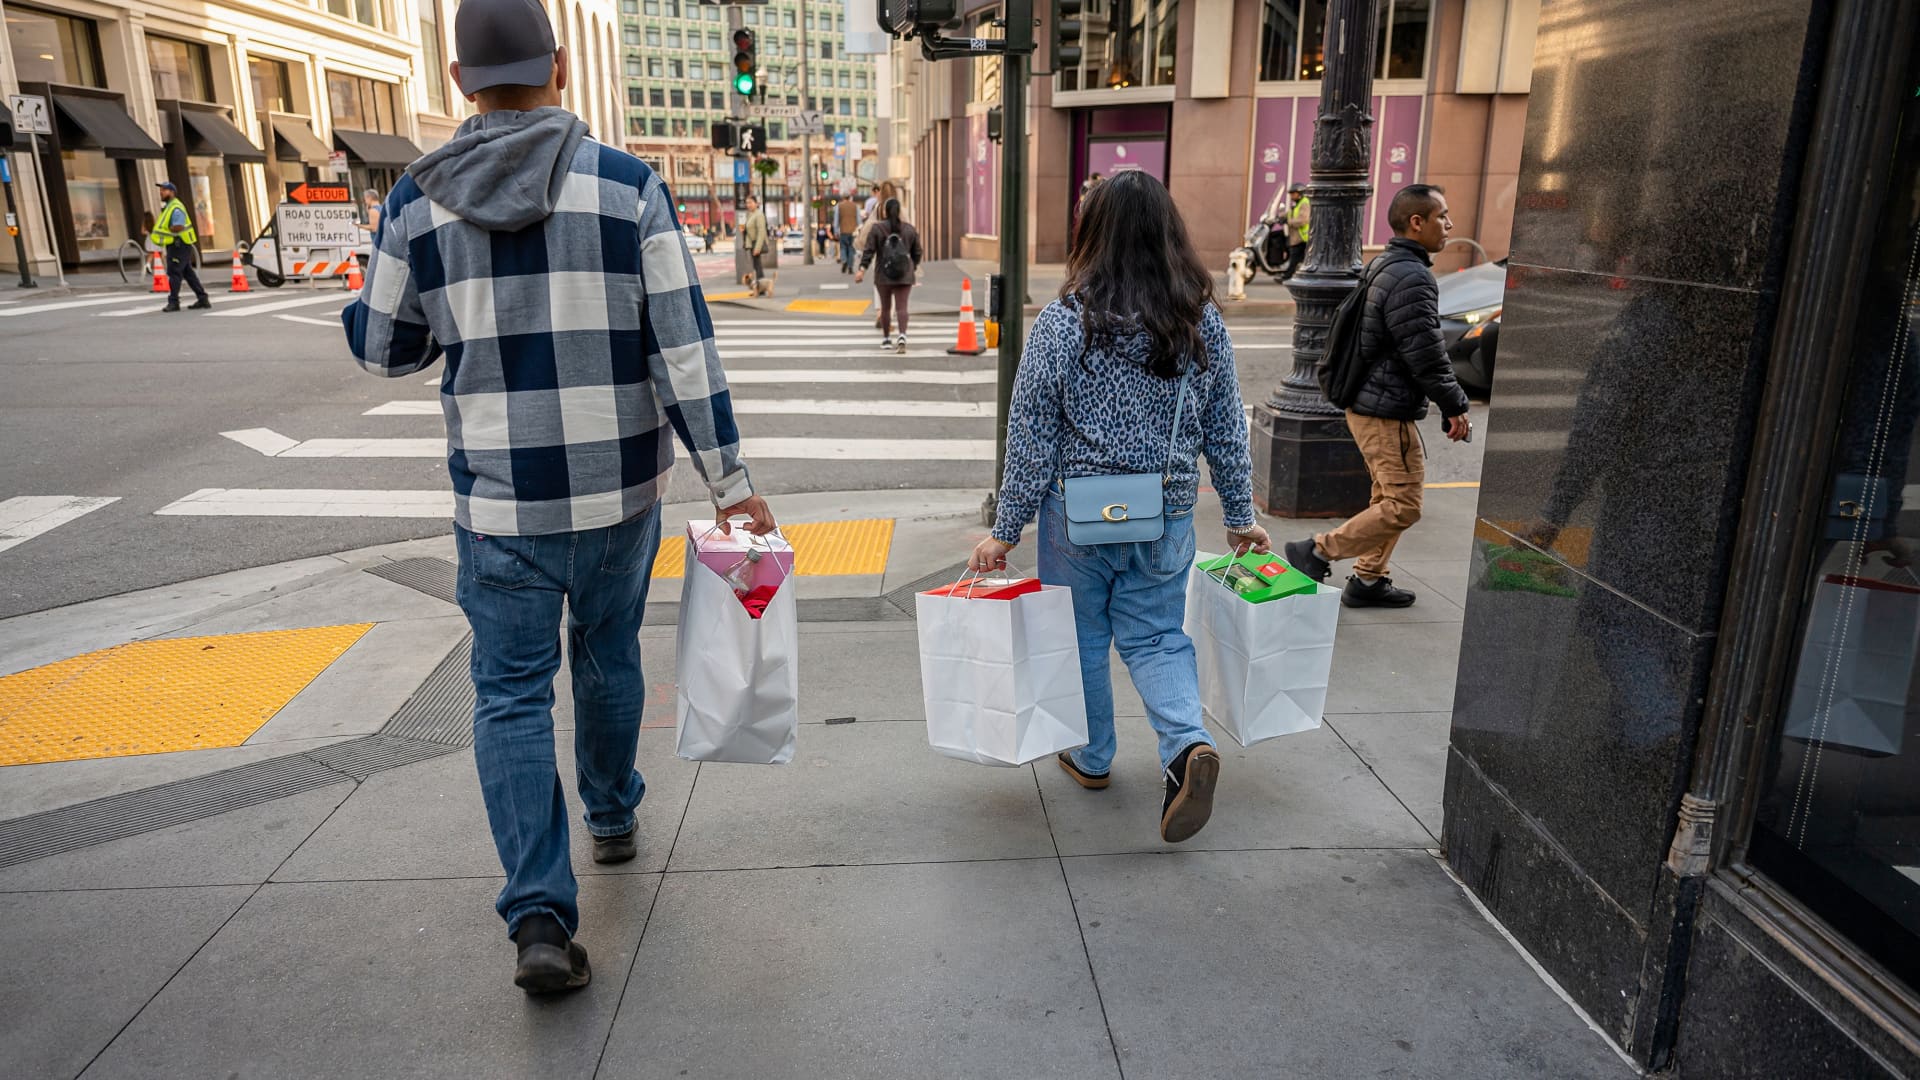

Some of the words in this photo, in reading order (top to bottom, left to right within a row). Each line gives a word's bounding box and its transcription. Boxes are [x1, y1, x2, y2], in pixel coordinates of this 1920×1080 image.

[754, 106, 796, 115] OFarrell
[306, 189, 345, 200] DETOUR
[285, 209, 311, 220] ROAD
[314, 209, 351, 220] CLOSED
[314, 222, 325, 230] TO
[287, 232, 312, 242] THRU
[316, 232, 354, 242] TRAFFIC
